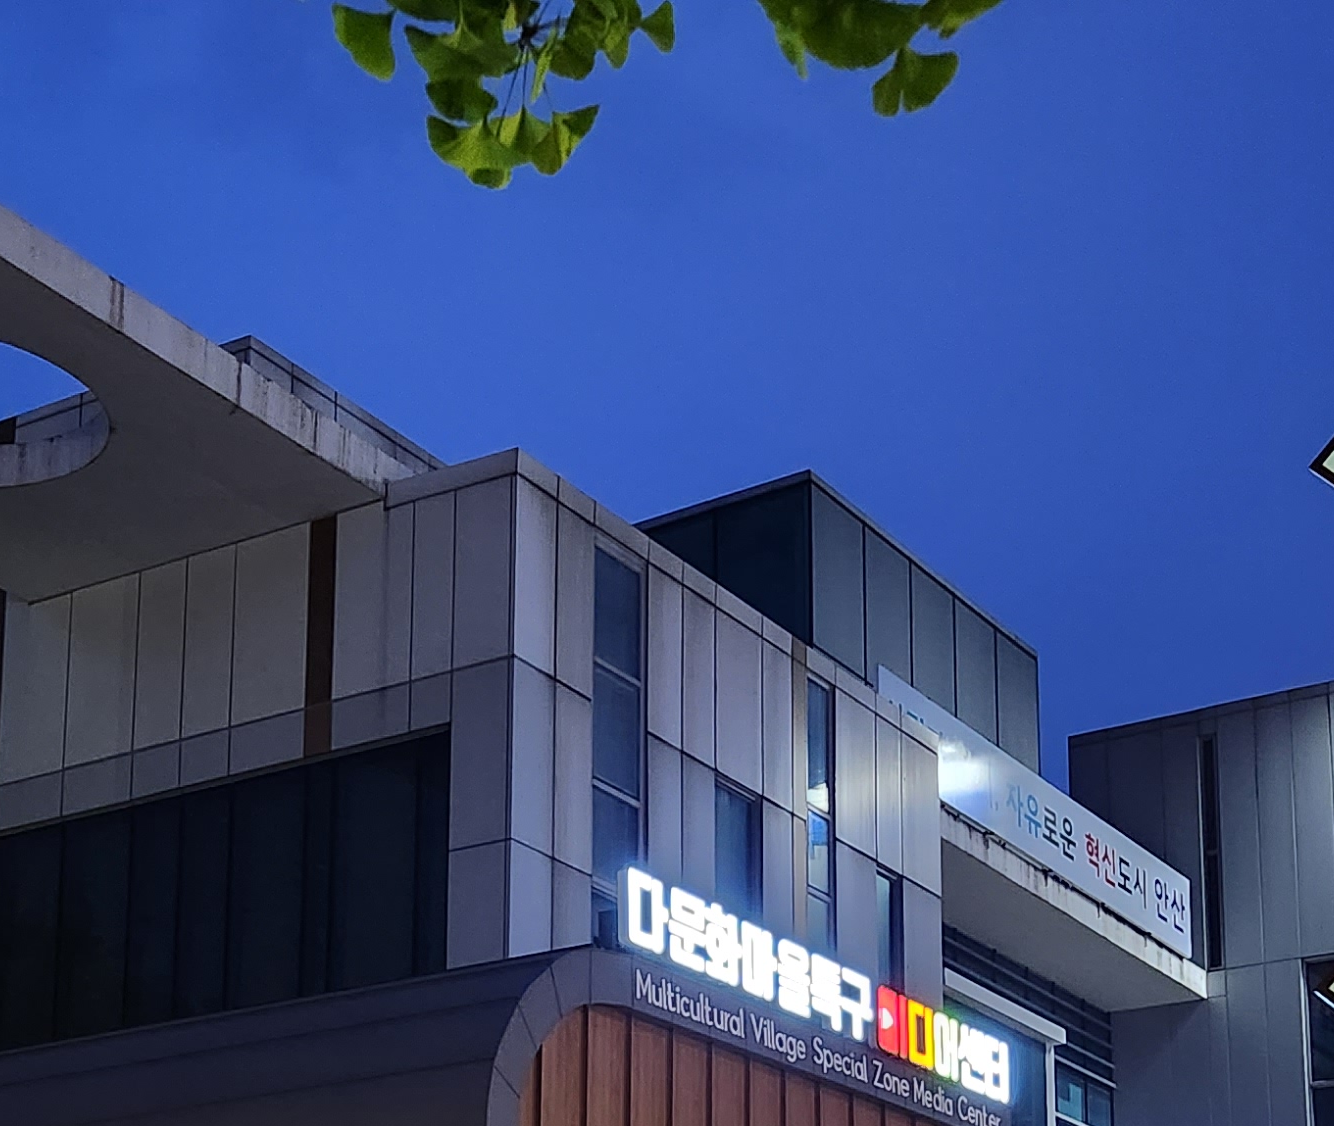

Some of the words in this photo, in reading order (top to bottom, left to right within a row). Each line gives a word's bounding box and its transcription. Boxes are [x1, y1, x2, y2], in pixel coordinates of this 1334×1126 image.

[1005, 783, 1077, 862] 자유로운
[1084, 832, 1147, 910] 혁신도시
[1154, 878, 1186, 934] 안산
[634, 968, 745, 1040] Multicultural
[750, 1012, 807, 1063] Village
[813, 1038, 868, 1084] Special
[873, 1060, 910, 1099] Zone
[912, 1077, 954, 1116] Media
